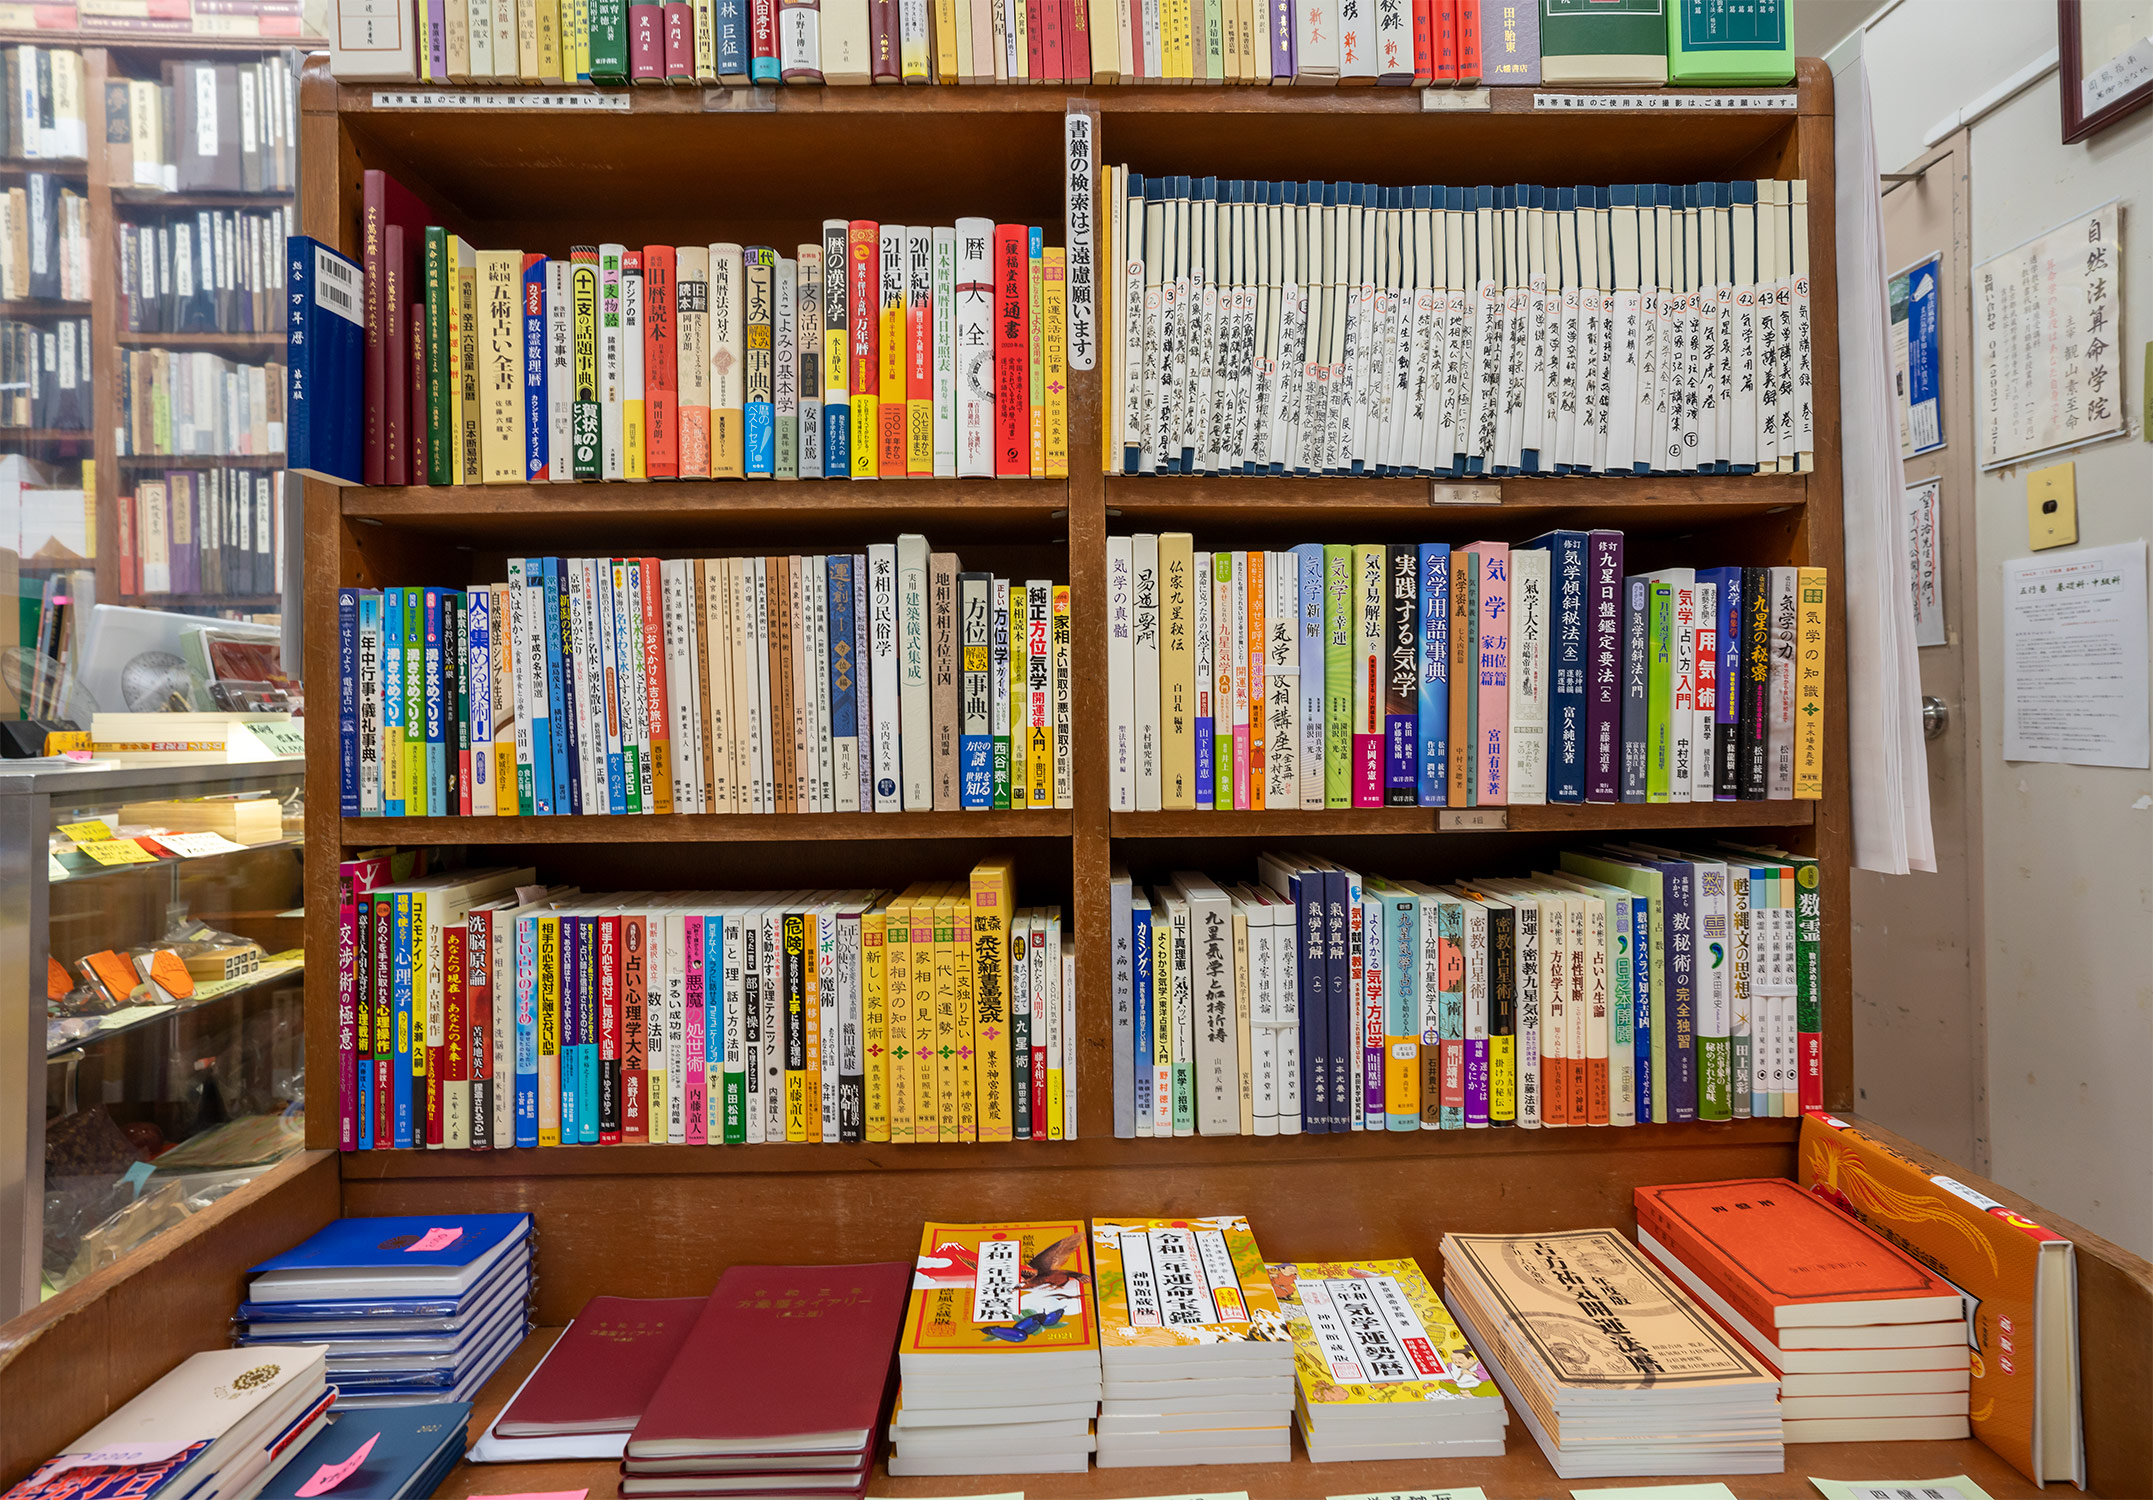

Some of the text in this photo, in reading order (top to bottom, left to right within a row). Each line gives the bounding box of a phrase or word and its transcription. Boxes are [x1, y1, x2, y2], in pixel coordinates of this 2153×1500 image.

[1344, 31, 1359, 64] 新本
[1383, 39, 1400, 69] 新本
[1537, 98, 1795, 107] 携帯電話のご使用及び撮影は、ご遠慮願います。
[882, 237, 902, 309] 21世紀暦
[909, 237, 930, 308] 20世紀暦
[1069, 119, 1092, 365] 書籍の検索はご遠慮願います。
[603, 255, 619, 328] 十二支物語
[626, 280, 636, 326] アジアの暦
[648, 268, 667, 342] 旧暦読本
[716, 258, 729, 343] 東西暦法の対立
[748, 267, 770, 323] こよみ
[801, 264, 819, 349] 干支の活学
[828, 237, 845, 323] 暦の漢字学
[937, 242, 951, 372] 日本暦西暦月日対照表
[964, 237, 985, 347] 暦大全
[1758, 292, 1773, 305] 43
[490, 284, 513, 391] 五術占い全書
[554, 321, 568, 368] 元号事典
[576, 274, 593, 388] 十二支の話題事典
[1003, 303, 1021, 340] 通書
[1047, 287, 1061, 374] 一代運気活断口伝書
[2084, 219, 2112, 422] 自然法算命学院
[464, 373, 476, 401] 九星暦
[748, 352, 770, 397] 事典
[777, 305, 794, 413] こよみの基本学
[804, 407, 817, 461] 安岡正篤
[509, 579, 523, 646] 病いは食から
[873, 559, 892, 657] 家相の民俗学
[935, 573, 952, 686] 地相家相方位吉凶
[965, 598, 987, 644] 方位
[1113, 558, 1129, 639] 気学の真髄
[1169, 560, 1185, 652] 仏家九星秘伝
[1303, 556, 1322, 638] 気学新解
[1329, 558, 1349, 647] 気学と幸運
[1364, 553, 1381, 638] 気学易解法
[1392, 554, 1417, 698] 実践する気学
[1425, 554, 1447, 684] 気学用語事典
[1561, 550, 1582, 641] 気学傾斜秘法
[1597, 552, 1617, 684] 九星日盤鑑定要法
[1778, 595, 1796, 660] 気学の力
[906, 592, 921, 679] 建築儀式集成
[1480, 635, 1493, 687] 家相篇
[1494, 635, 1507, 687] 方位篇
[1630, 612, 1644, 699] 気学傾斜法入門
[1679, 629, 1692, 672] 占い方
[1751, 595, 1769, 682] 九星の秘密
[1803, 611, 1821, 698] 気学の知識
[361, 636, 376, 763] 年中行事・儀礼事典
[966, 676, 987, 720] 事典
[1562, 706, 1577, 764] 富久純光著
[841, 744, 851, 780] 賀川礼子
[994, 742, 1007, 798] 西谷泰人
[413, 903, 423, 972] コスモナイン
[469, 915, 487, 988] 洗脳原論
[786, 919, 803, 953] 危険
[1733, 878, 1750, 1000] 甦る縄文の思想
[1798, 893, 1821, 942] 数霊
[820, 918, 835, 1008] シンボルの魔術
[865, 950, 884, 1040] 新しい家相術
[890, 950, 908, 1039] 家相学の知識
[914, 951, 932, 1040] 家相の見方
[936, 950, 953, 1036] 一代之運勢
[955, 950, 971, 1039] 十二支独り占い
[1550, 951, 1564, 1017] 方位学入門
[1571, 951, 1583, 1002] 相性判断
[1592, 951, 1605, 1018] 占い人生論
[625, 955, 642, 1071] 占い心理学大全
[669, 979, 682, 1041] ずるい成功術
[686, 975, 704, 1073] 悪魔の処世術
[746, 978, 759, 1039] 部下を操る
[1015, 1019, 1029, 1069] 九星術
[627, 1076, 638, 1118] 浅野八郎
[727, 1082, 739, 1125] 岩田松雄
